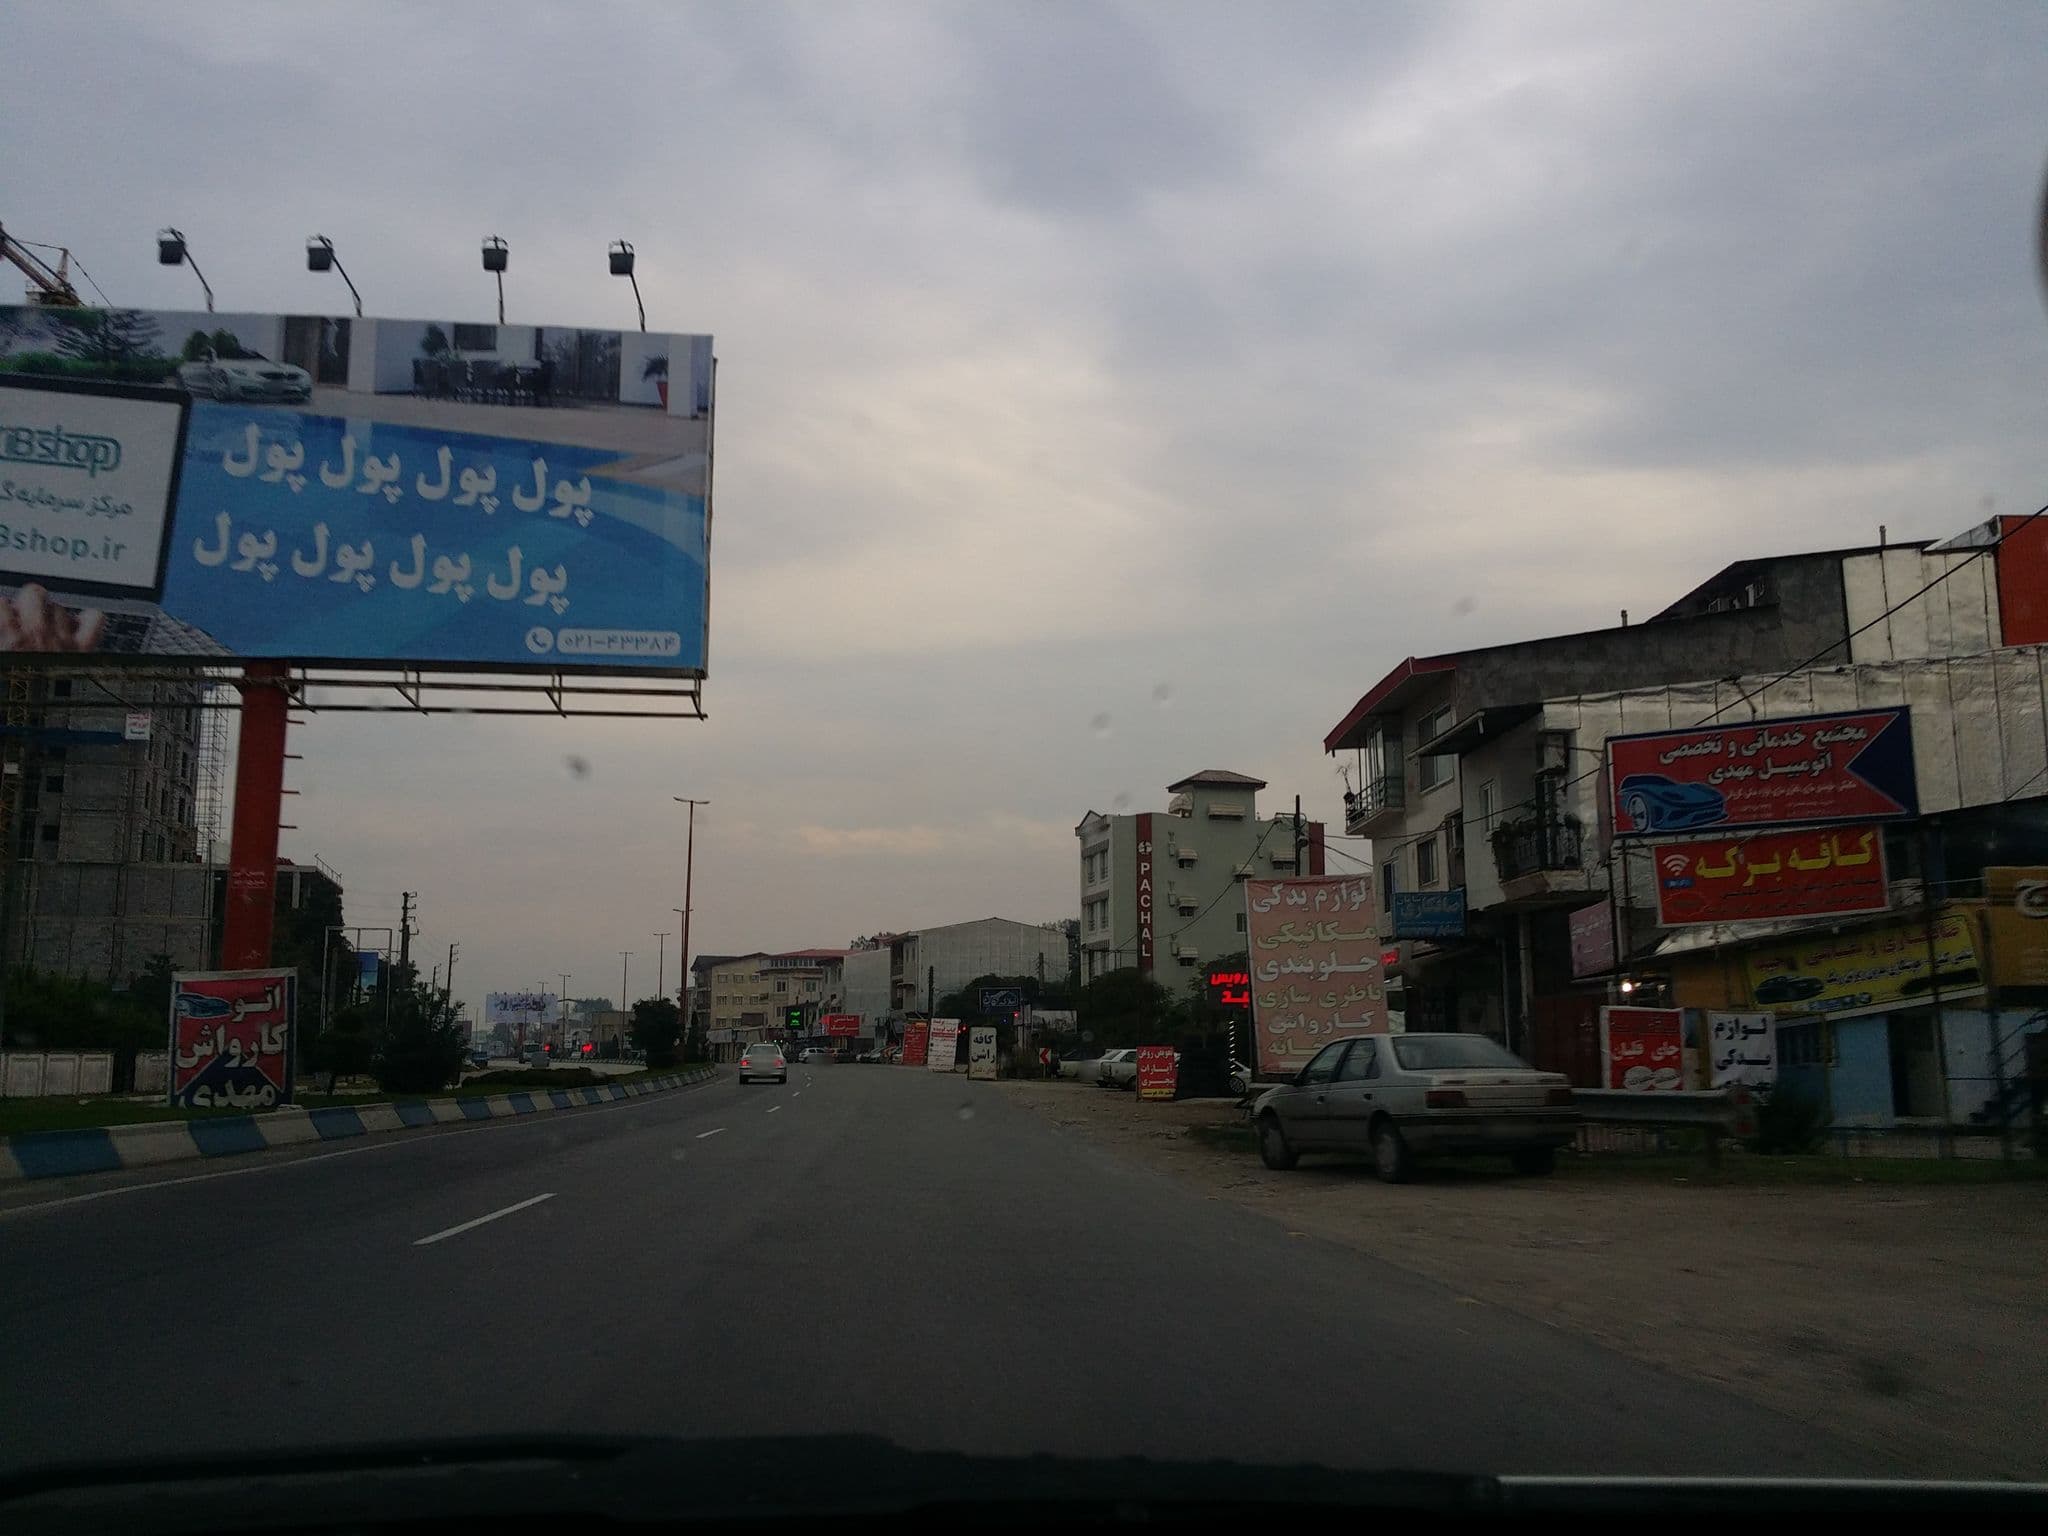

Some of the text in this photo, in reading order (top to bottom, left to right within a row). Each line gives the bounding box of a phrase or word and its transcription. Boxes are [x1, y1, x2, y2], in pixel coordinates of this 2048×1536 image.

[223, 422, 596, 528] پول پول پول پول
[193, 511, 570, 615] پول پول پول پول
[1658, 723, 1868, 765] مجتمع خدماتی و تخصصی
[1707, 751, 1833, 785] اتومبیل مهدی
[1787, 831, 1874, 871] کافه
[1140, 861, 1152, 957] PACHAL
[1252, 880, 1368, 912] لوازم یدکی
[1256, 921, 1378, 949] مکانیکی
[1210, 972, 1249, 987] رویس
[231, 984, 282, 1023] اتو
[973, 1032, 994, 1045] کافه
[1268, 1010, 1376, 1034] کارواش
[1715, 1017, 1767, 1040] لوازم
[176, 1021, 288, 1069] کارواش
[1717, 1048, 1771, 1071] یدکی
